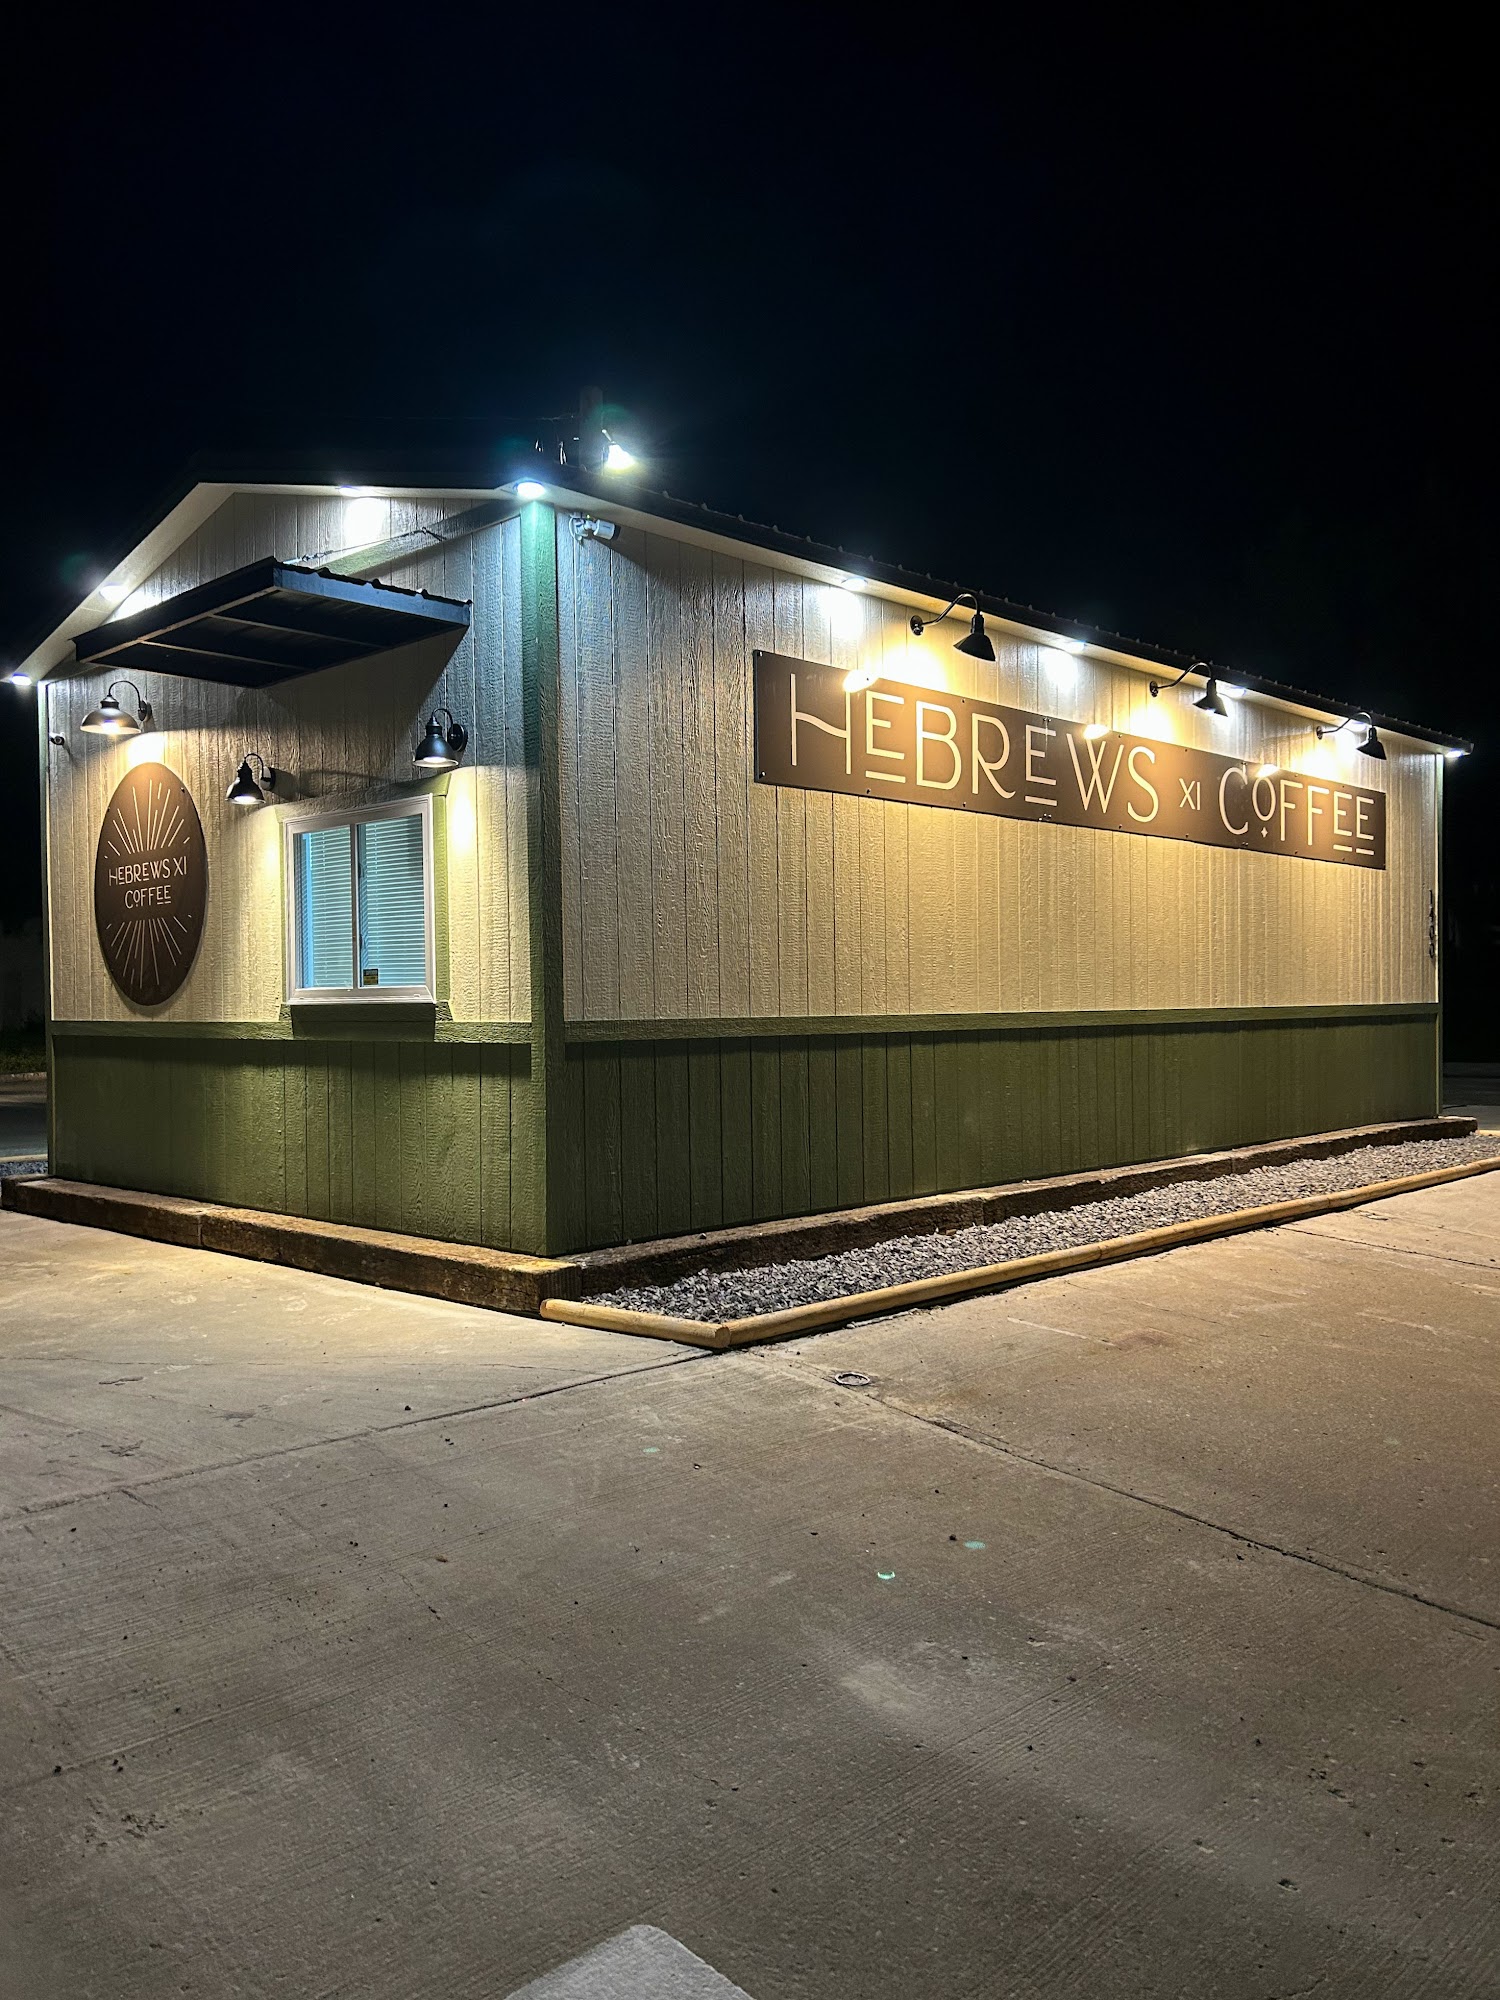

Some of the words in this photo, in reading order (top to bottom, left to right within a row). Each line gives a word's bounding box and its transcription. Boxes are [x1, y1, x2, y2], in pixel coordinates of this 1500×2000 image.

[790, 673, 1159, 823] HEBREWS
[1179, 778, 1201, 811] XI
[1218, 766, 1375, 856] COFFEE
[108, 858, 171, 887] HEBREWS
[173, 855, 187, 877] XI
[124, 884, 172, 909] COFFEE
